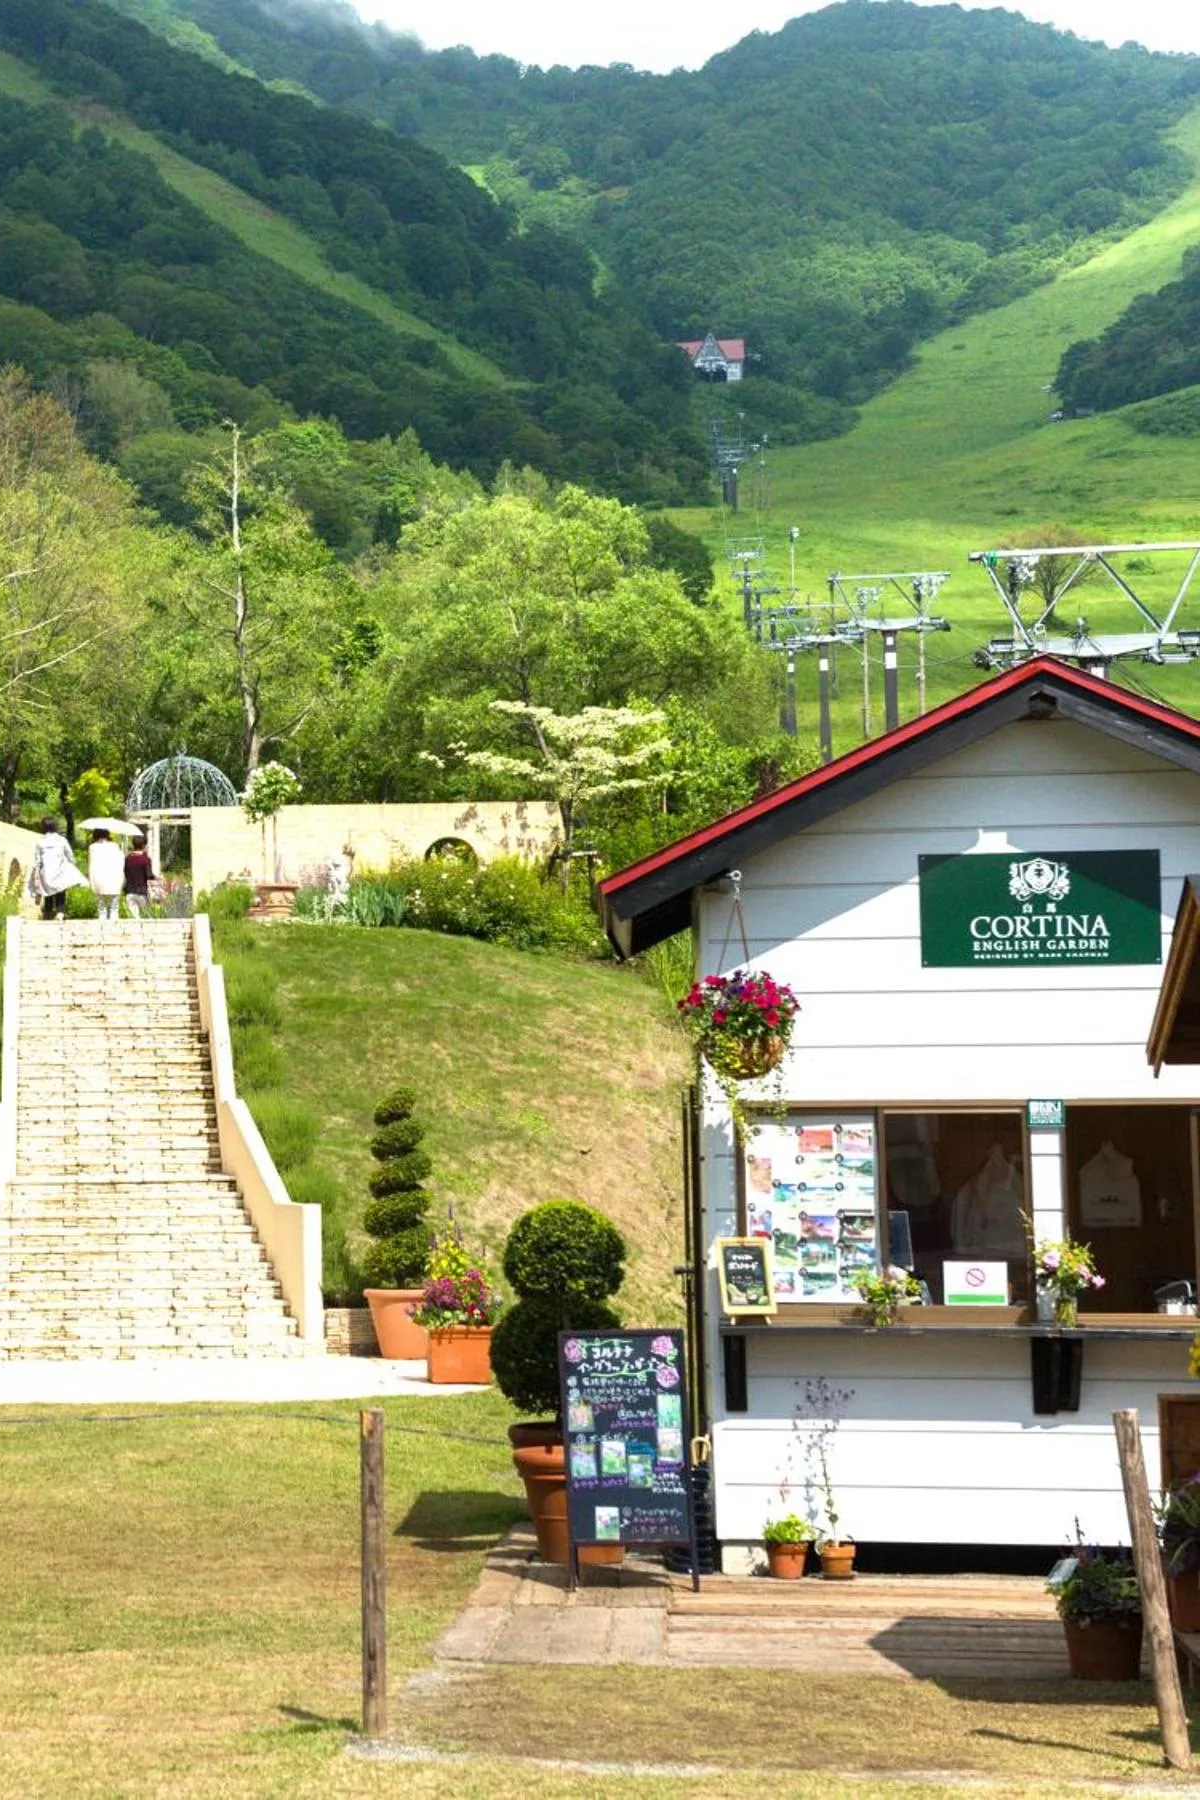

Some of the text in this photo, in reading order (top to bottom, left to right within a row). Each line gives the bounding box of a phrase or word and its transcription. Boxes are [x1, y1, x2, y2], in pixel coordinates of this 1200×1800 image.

[970, 914, 1111, 939] CORTINA
[973, 938, 1109, 951] ENGLISH GARDEN
